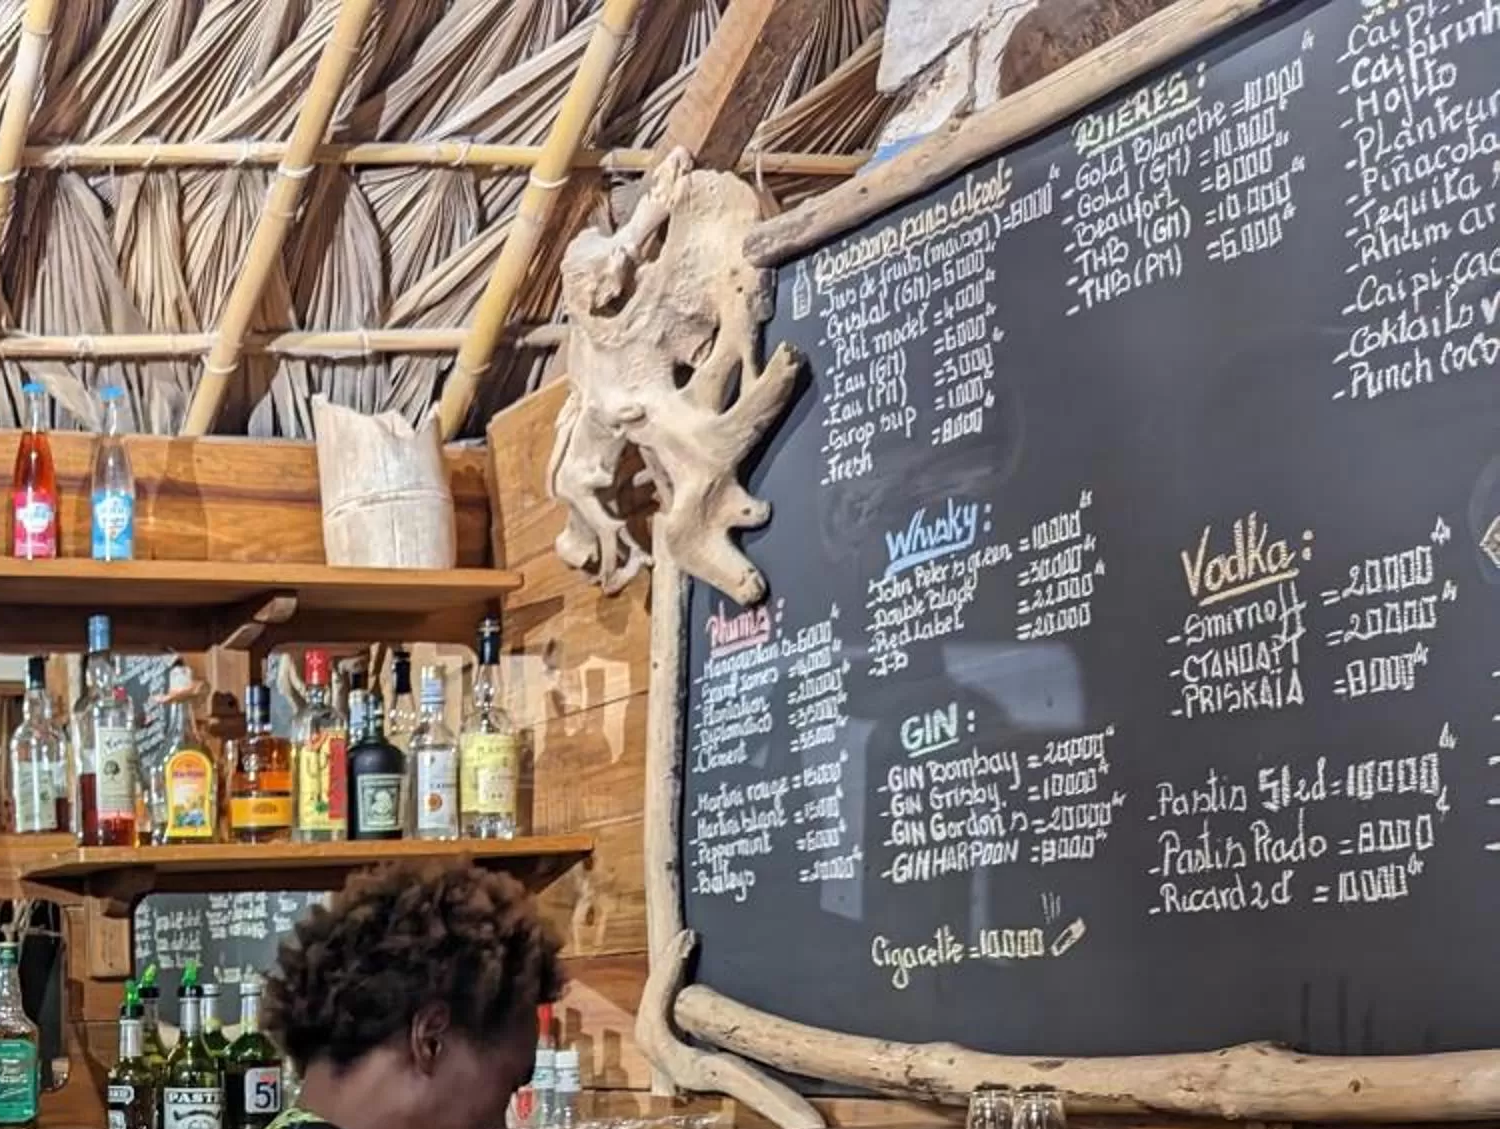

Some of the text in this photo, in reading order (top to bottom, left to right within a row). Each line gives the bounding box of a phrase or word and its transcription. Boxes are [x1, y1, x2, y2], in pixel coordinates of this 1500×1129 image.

[1076, 147, 1127, 192] Gold
[1132, 101, 1227, 162] Blanche
[1073, 178, 1179, 247] Beaufort
[1077, 171, 1130, 218] Gold
[1074, 236, 1129, 276] THB
[1144, 205, 1191, 249] (GM)
[1077, 269, 1131, 308] THB
[1134, 244, 1183, 287] (PM)
[826, 296, 892, 340] Cristal
[833, 371, 867, 400] Eau
[868, 347, 907, 385] (GM)
[1349, 347, 1433, 399] Punch
[829, 400, 863, 425] Eau
[867, 376, 907, 412] (PM)
[887, 746, 1020, 793] GIN Bombay
[890, 793, 922, 818] GIN
[891, 820, 928, 847] GIN
[892, 850, 930, 884] GIN
[1159, 873, 1247, 912] Ricard
[871, 925, 965, 989] Cigarette
